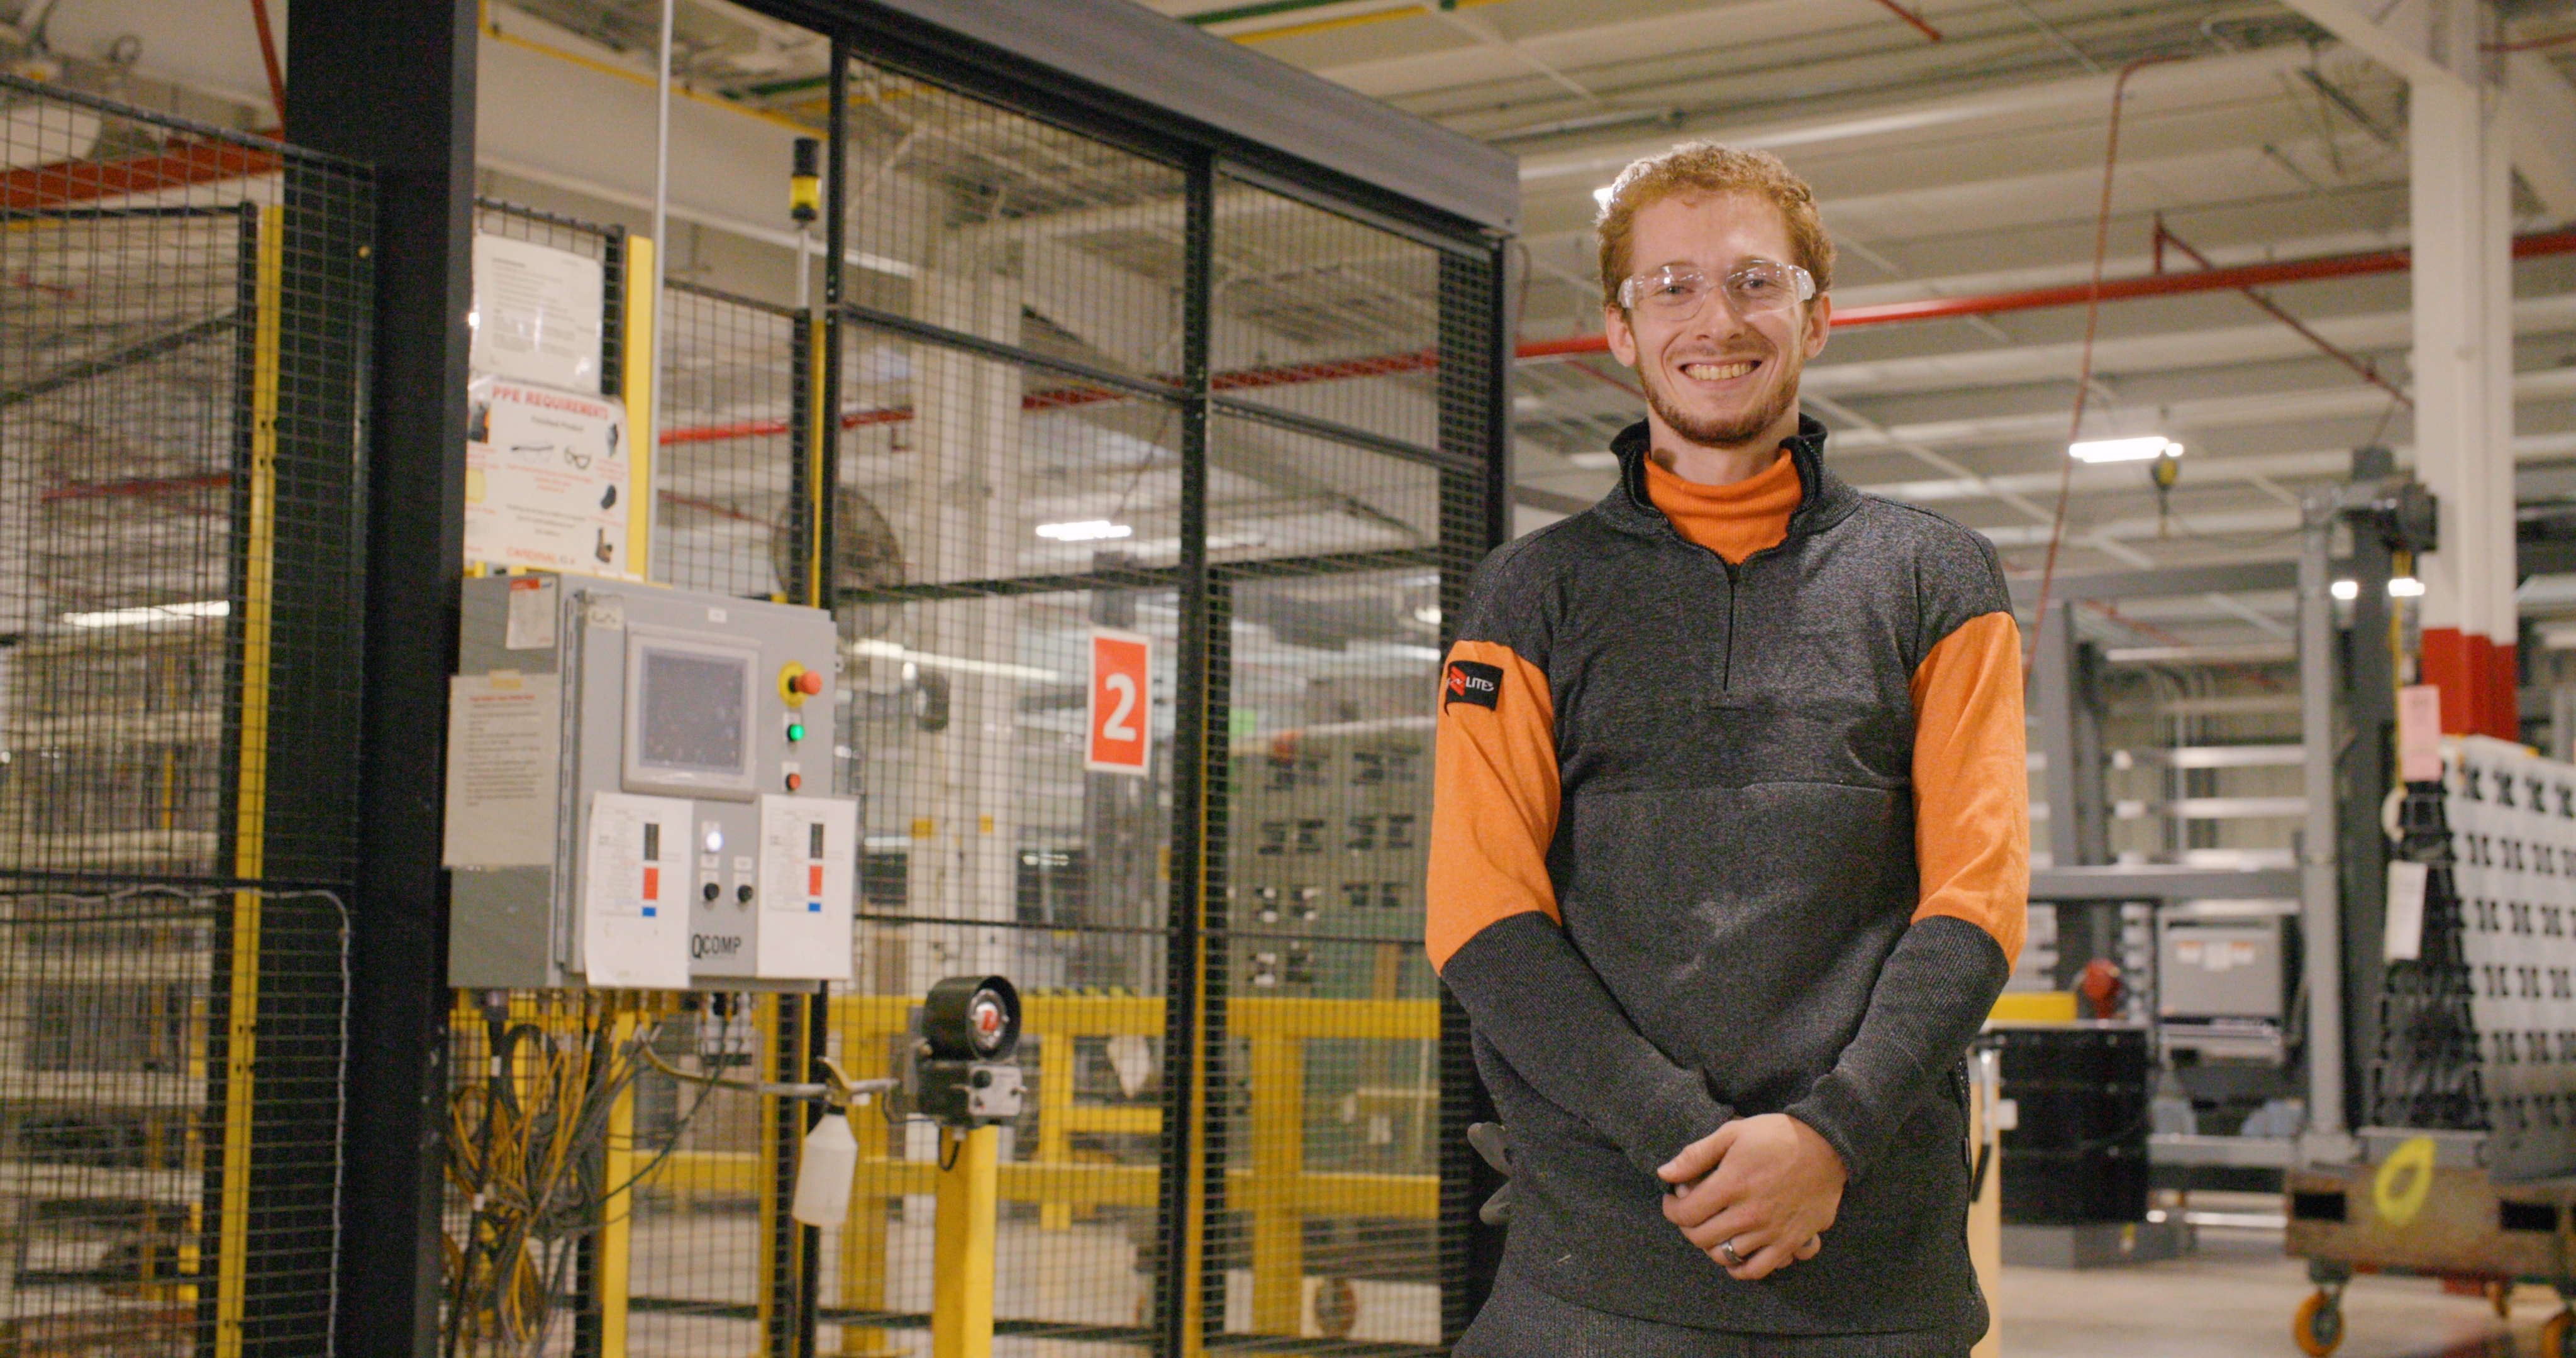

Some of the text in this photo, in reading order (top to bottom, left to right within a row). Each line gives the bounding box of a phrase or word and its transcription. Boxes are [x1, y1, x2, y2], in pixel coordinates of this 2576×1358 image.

[493, 385, 609, 421] PPE REQUIREMENTS
[1102, 673, 1137, 742] 2
[692, 934, 742, 959] QCOMP
